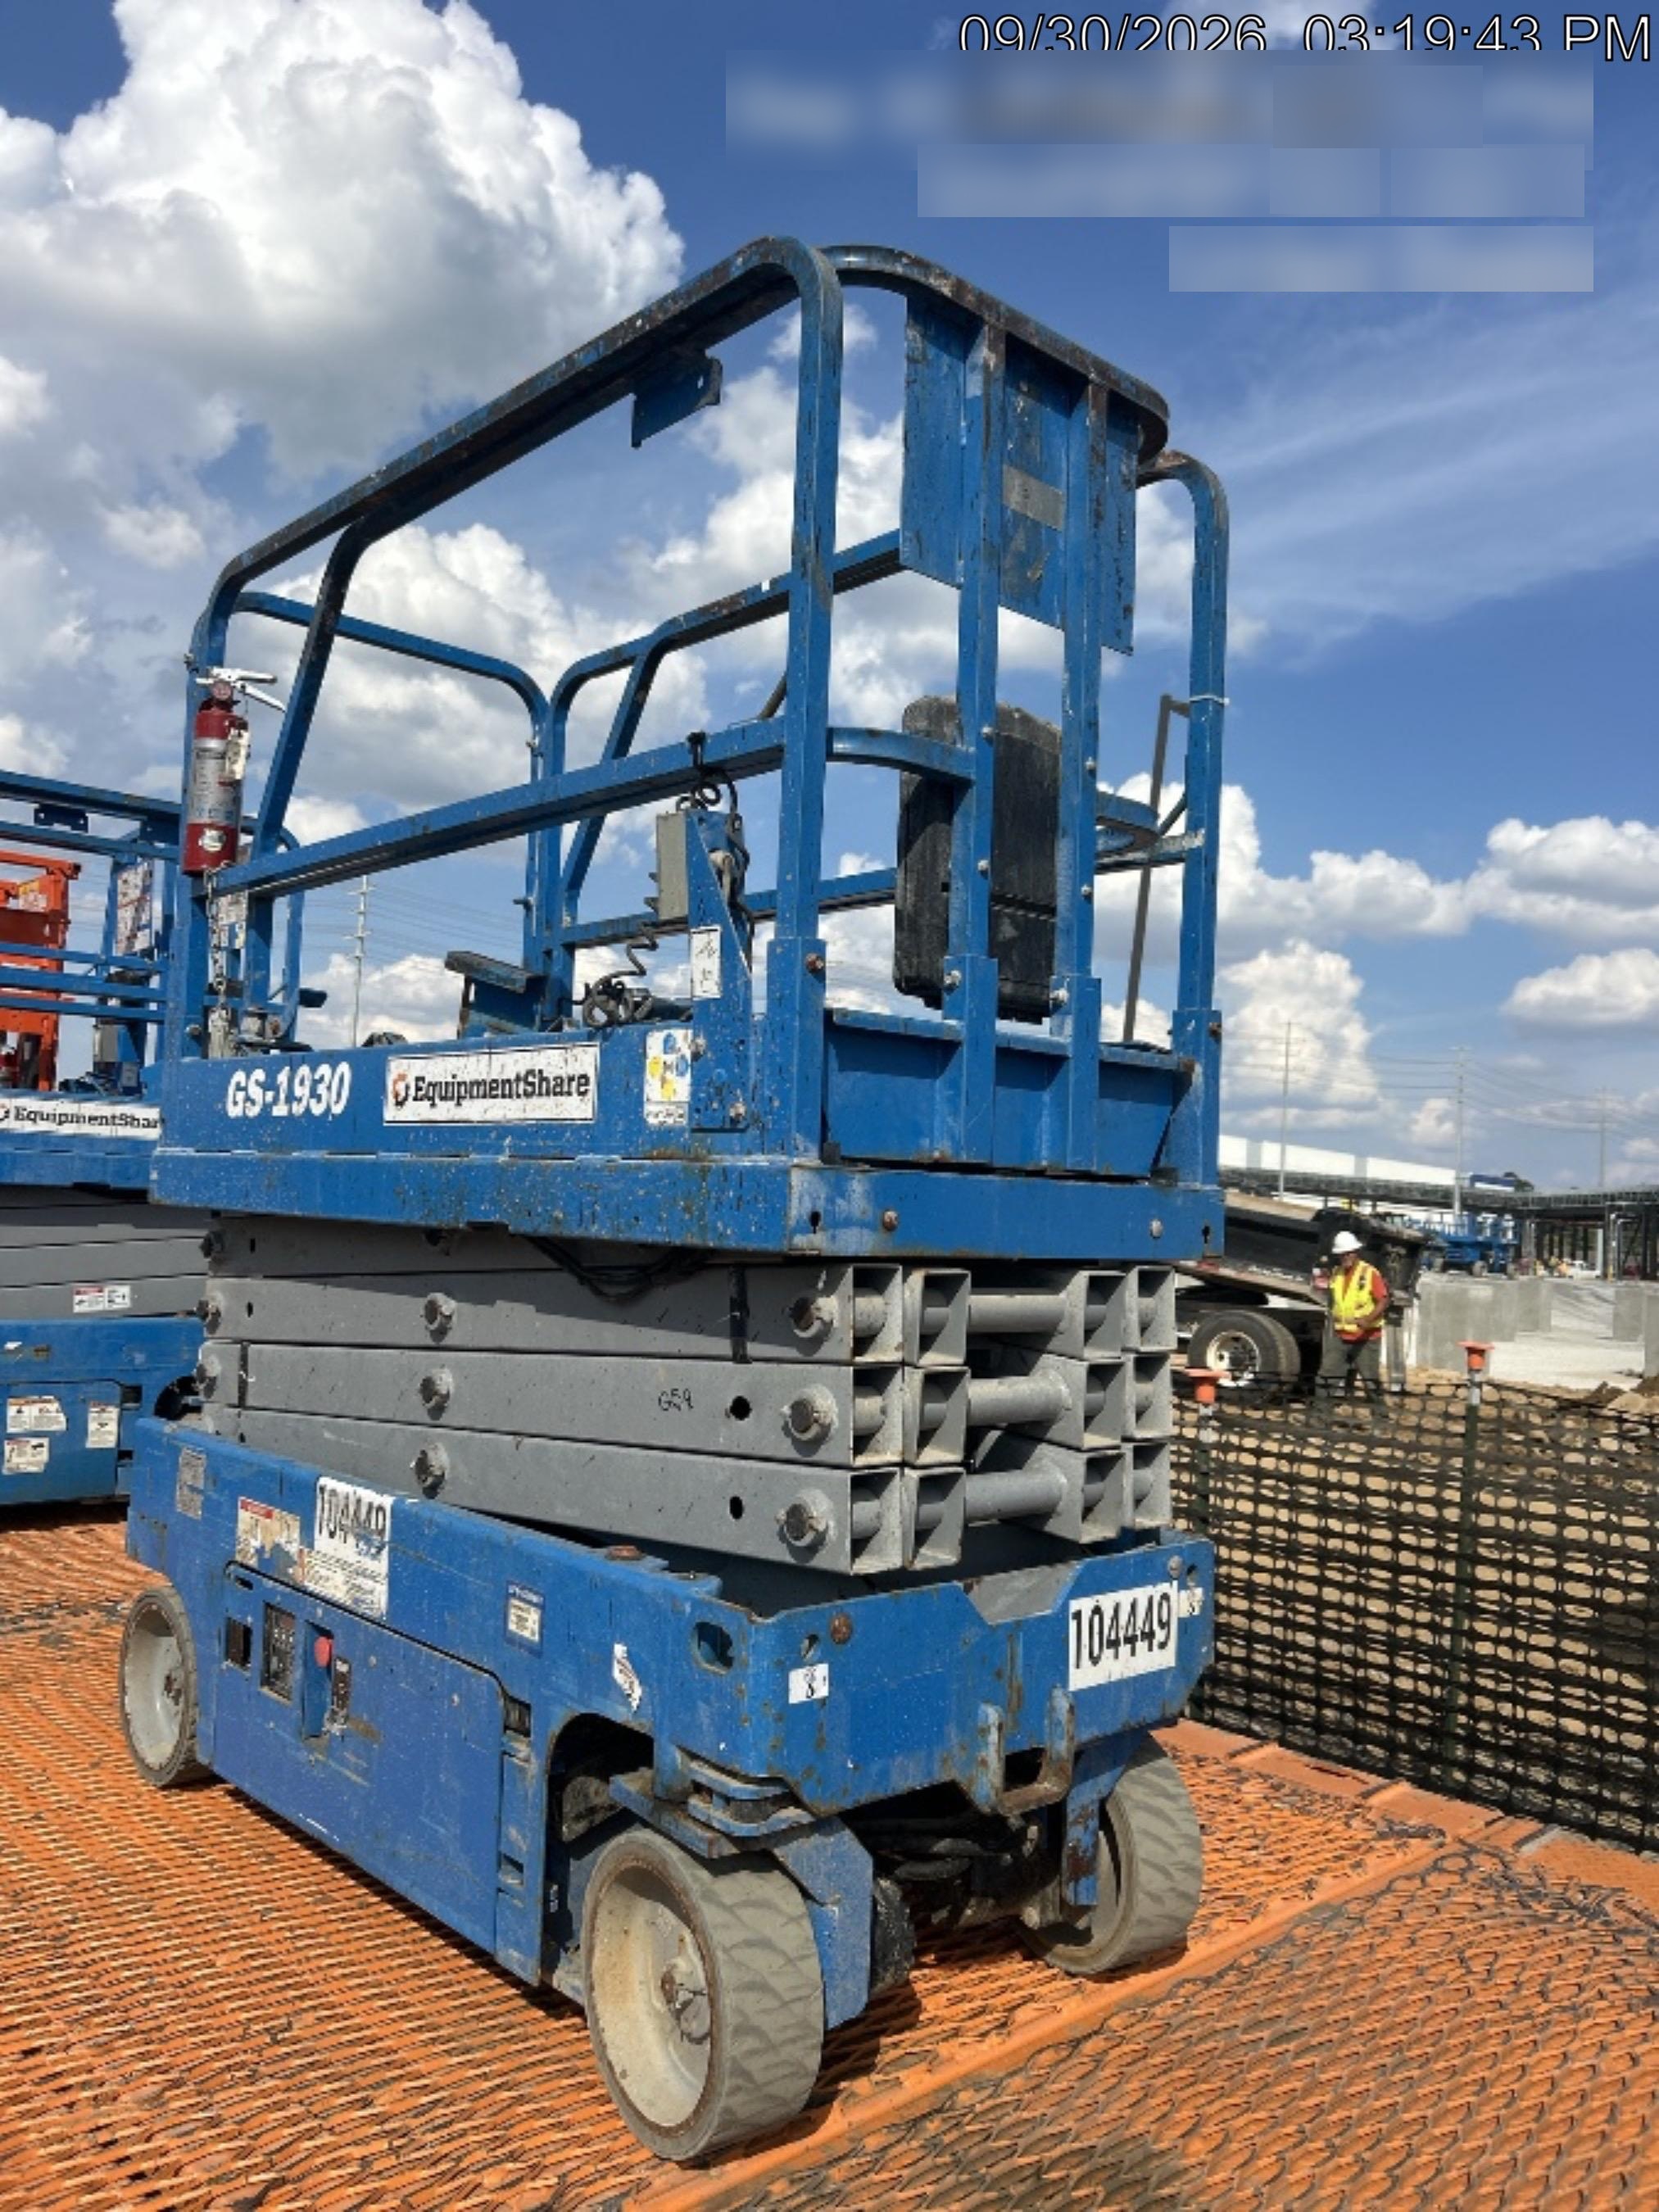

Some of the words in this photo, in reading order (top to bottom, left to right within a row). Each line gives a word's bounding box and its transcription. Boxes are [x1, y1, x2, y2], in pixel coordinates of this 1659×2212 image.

[225, 1062, 351, 1117] GS-1930
[412, 1069, 591, 1108] EquipmentShare
[14, 1105, 158, 1129] EquipmentShar
[1072, 1591, 1172, 1669] 104449
